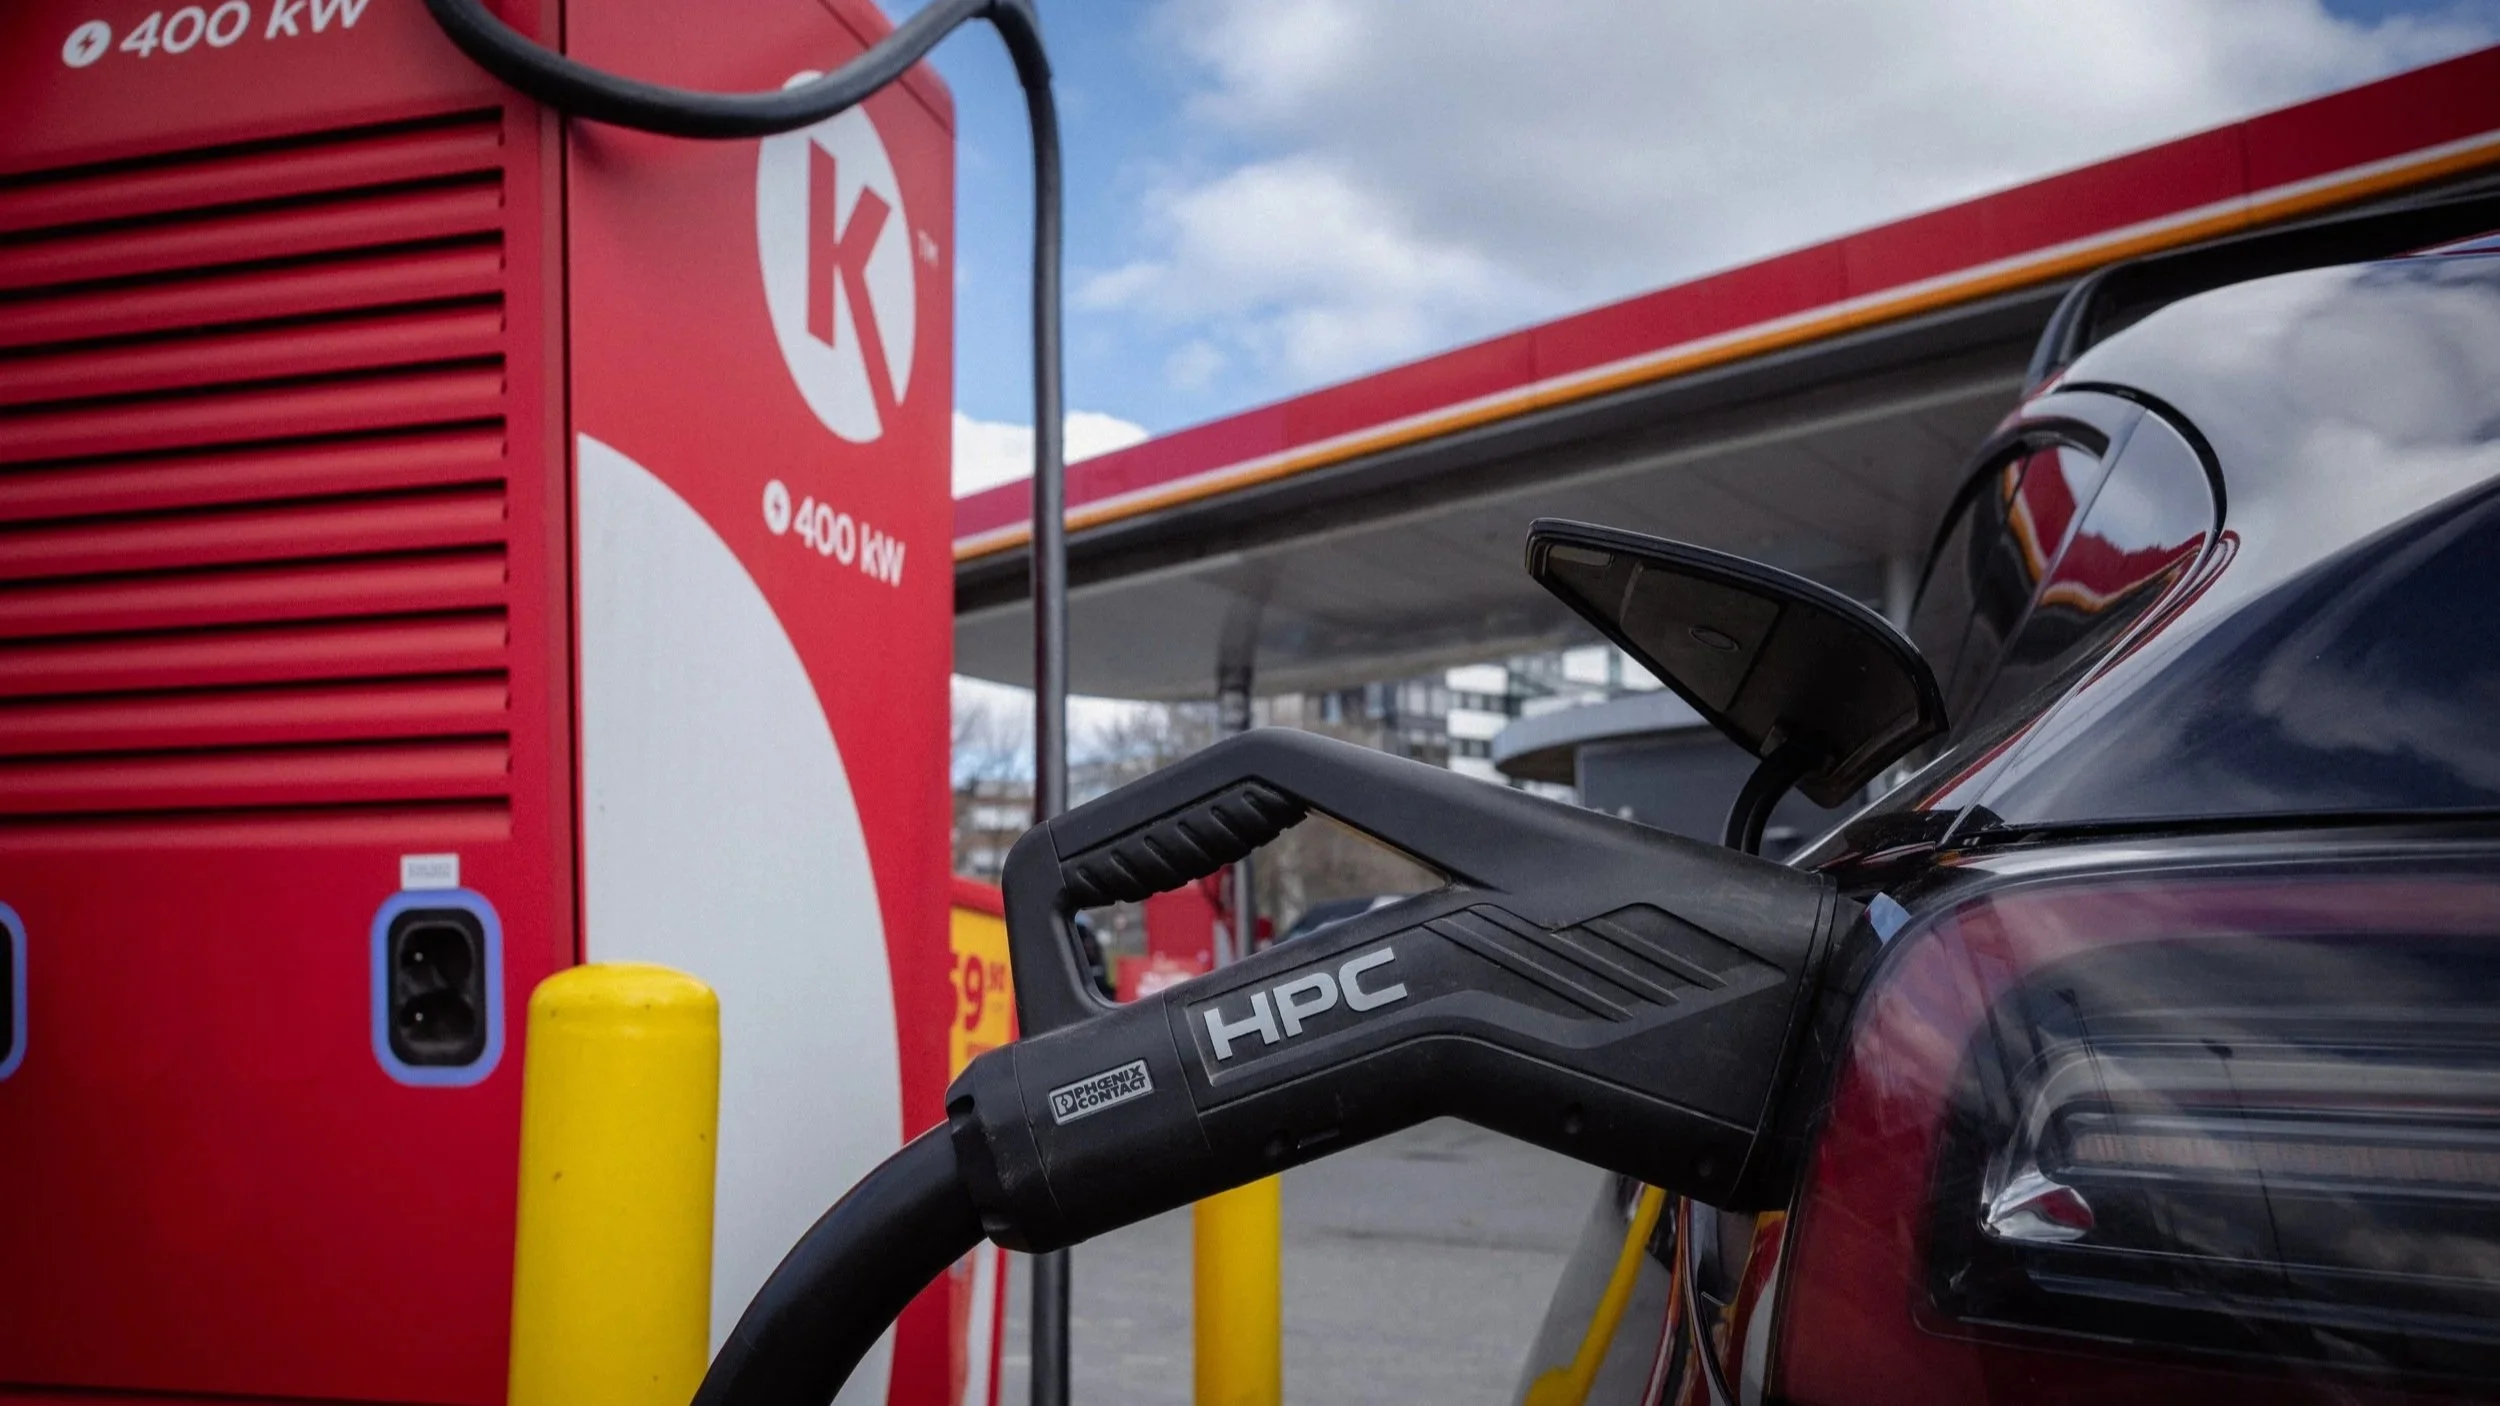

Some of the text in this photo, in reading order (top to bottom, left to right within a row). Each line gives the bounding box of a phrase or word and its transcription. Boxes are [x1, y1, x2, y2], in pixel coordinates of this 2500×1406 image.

[119, 0, 369, 58] 400 kW
[806, 136, 901, 437] K
[793, 495, 906, 588] 400 kW
[1203, 947, 1407, 1061] HPC
[1078, 1076, 1146, 1109] CONTACT
